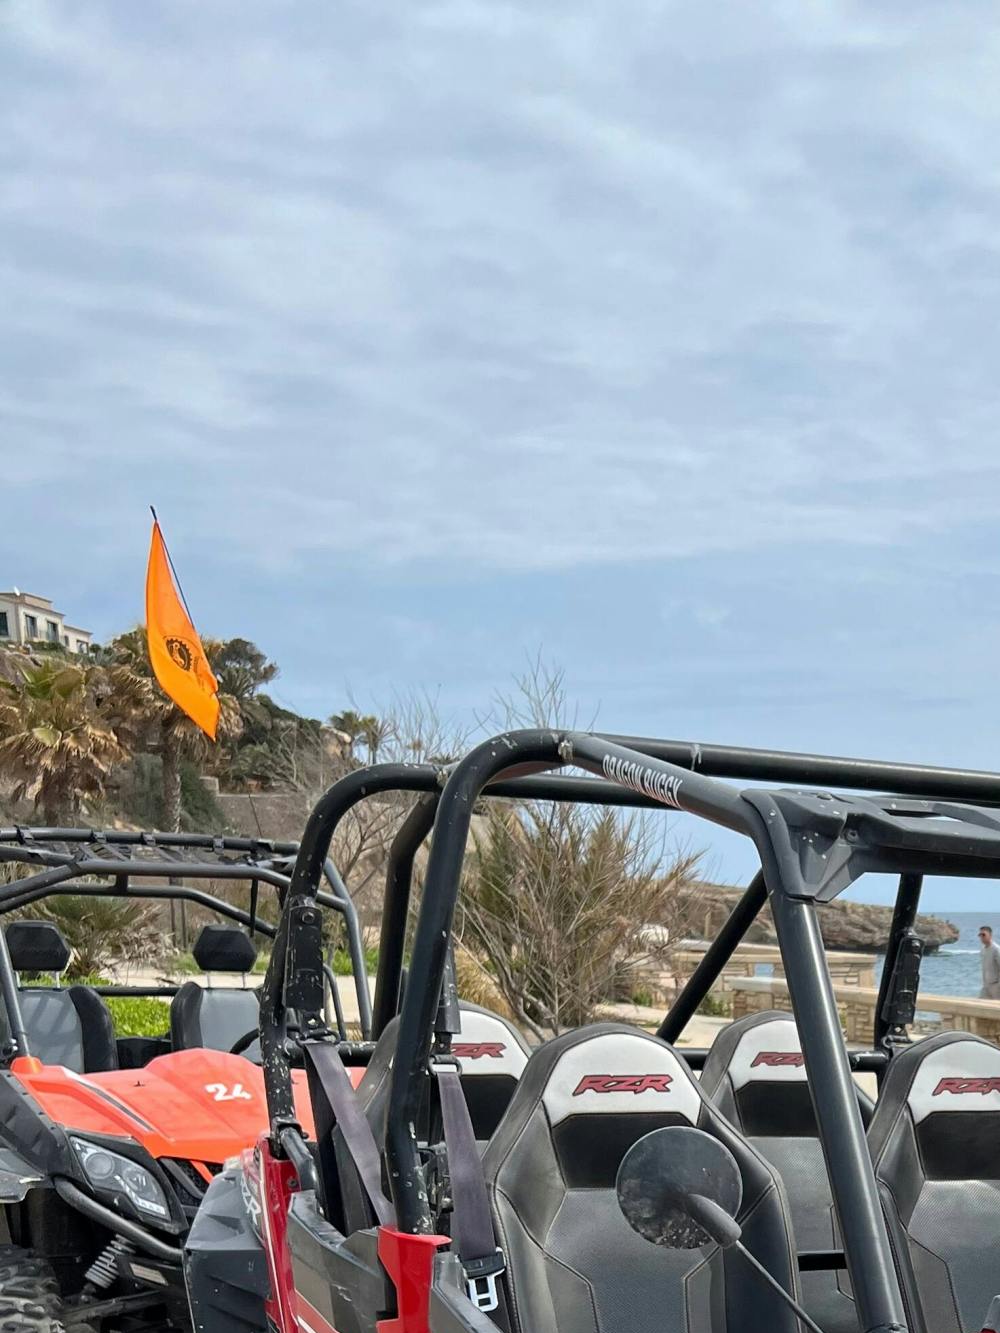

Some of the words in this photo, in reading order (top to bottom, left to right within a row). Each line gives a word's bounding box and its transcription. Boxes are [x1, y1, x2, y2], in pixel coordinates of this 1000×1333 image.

[450, 1043, 506, 1059] ZR
[751, 1052, 804, 1067] RZ
[204, 1083, 252, 1101] 24
[572, 1074, 674, 1097] RZR
